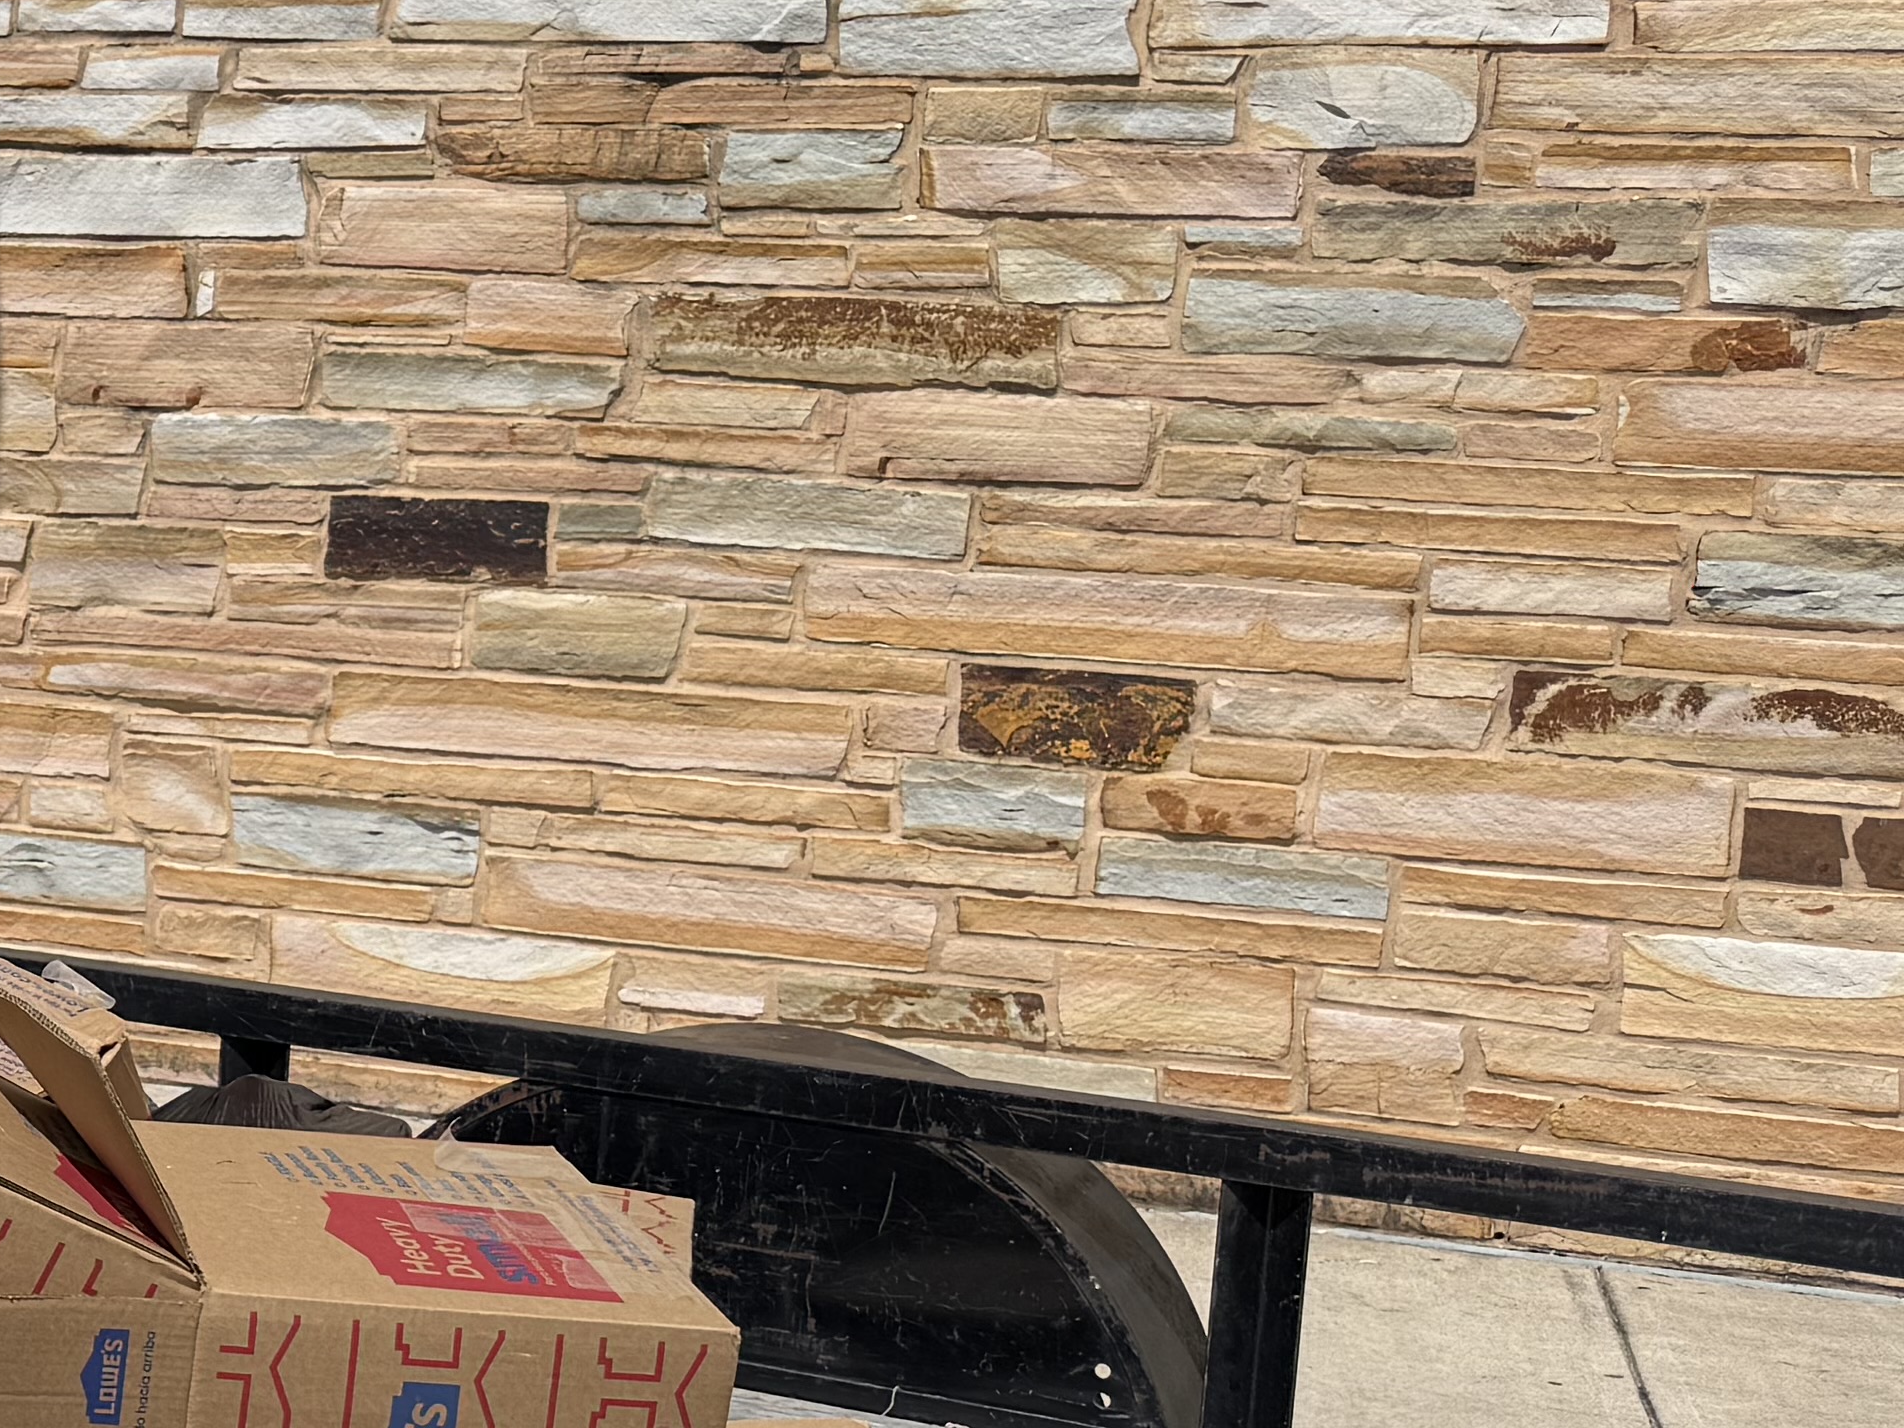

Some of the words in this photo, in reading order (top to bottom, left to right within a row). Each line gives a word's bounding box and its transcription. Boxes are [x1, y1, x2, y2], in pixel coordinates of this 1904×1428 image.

[376, 1217, 441, 1277] Heavy
[428, 1233, 485, 1280] Duty
[94, 1337, 124, 1416] LOWE'S
[143, 1331, 156, 1372] arriba
